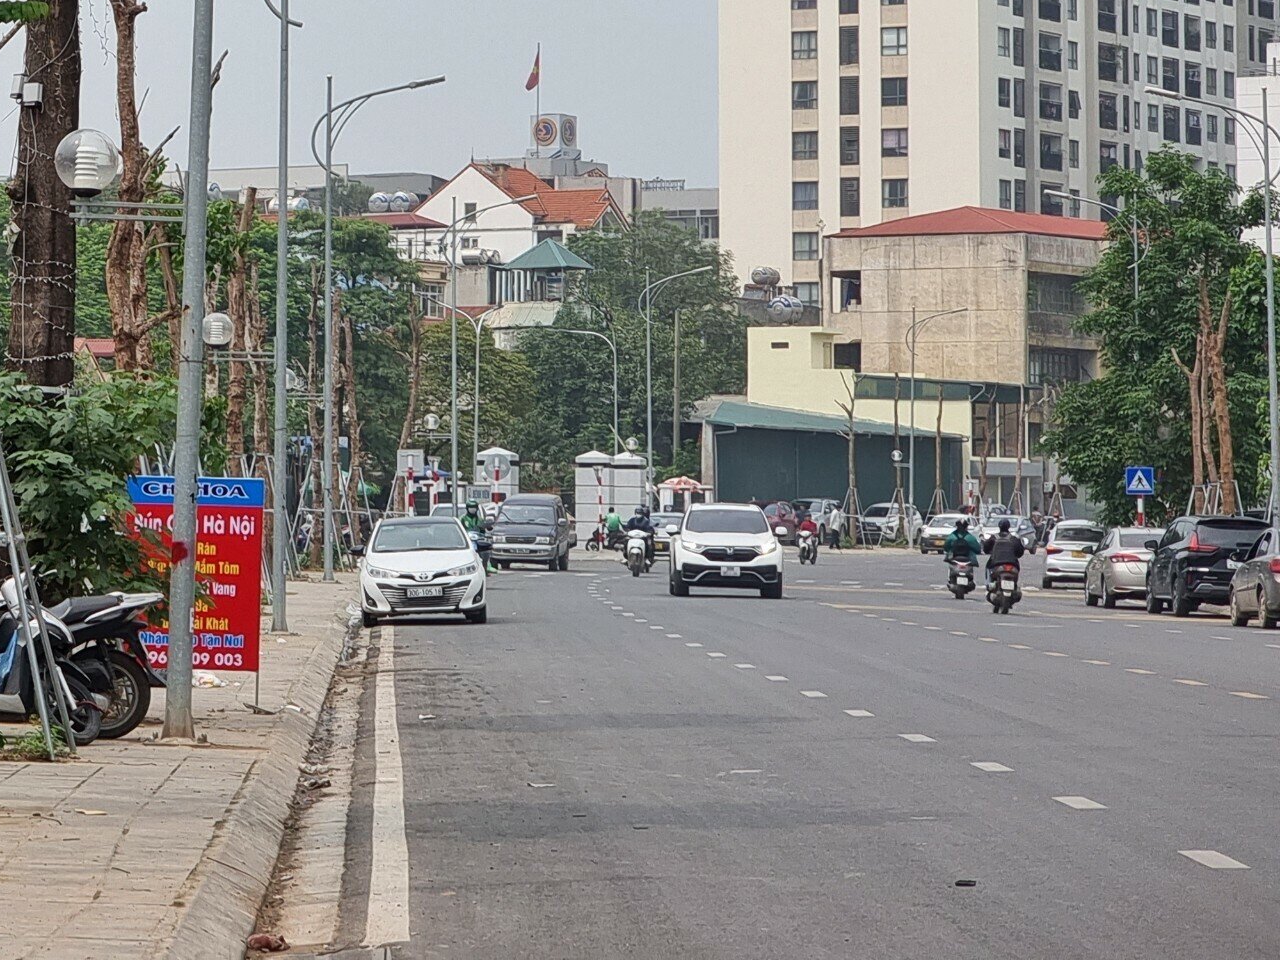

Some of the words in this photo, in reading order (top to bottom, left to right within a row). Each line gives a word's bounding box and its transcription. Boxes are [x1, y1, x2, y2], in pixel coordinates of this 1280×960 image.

[203, 513, 225, 535] Hà
[229, 514, 255, 541] Nội
[212, 582, 236, 597] Vang
[206, 618, 229, 631] Khát
[148, 651, 168, 665] 96
[192, 652, 210, 666] 09
[214, 653, 243, 667] 003
